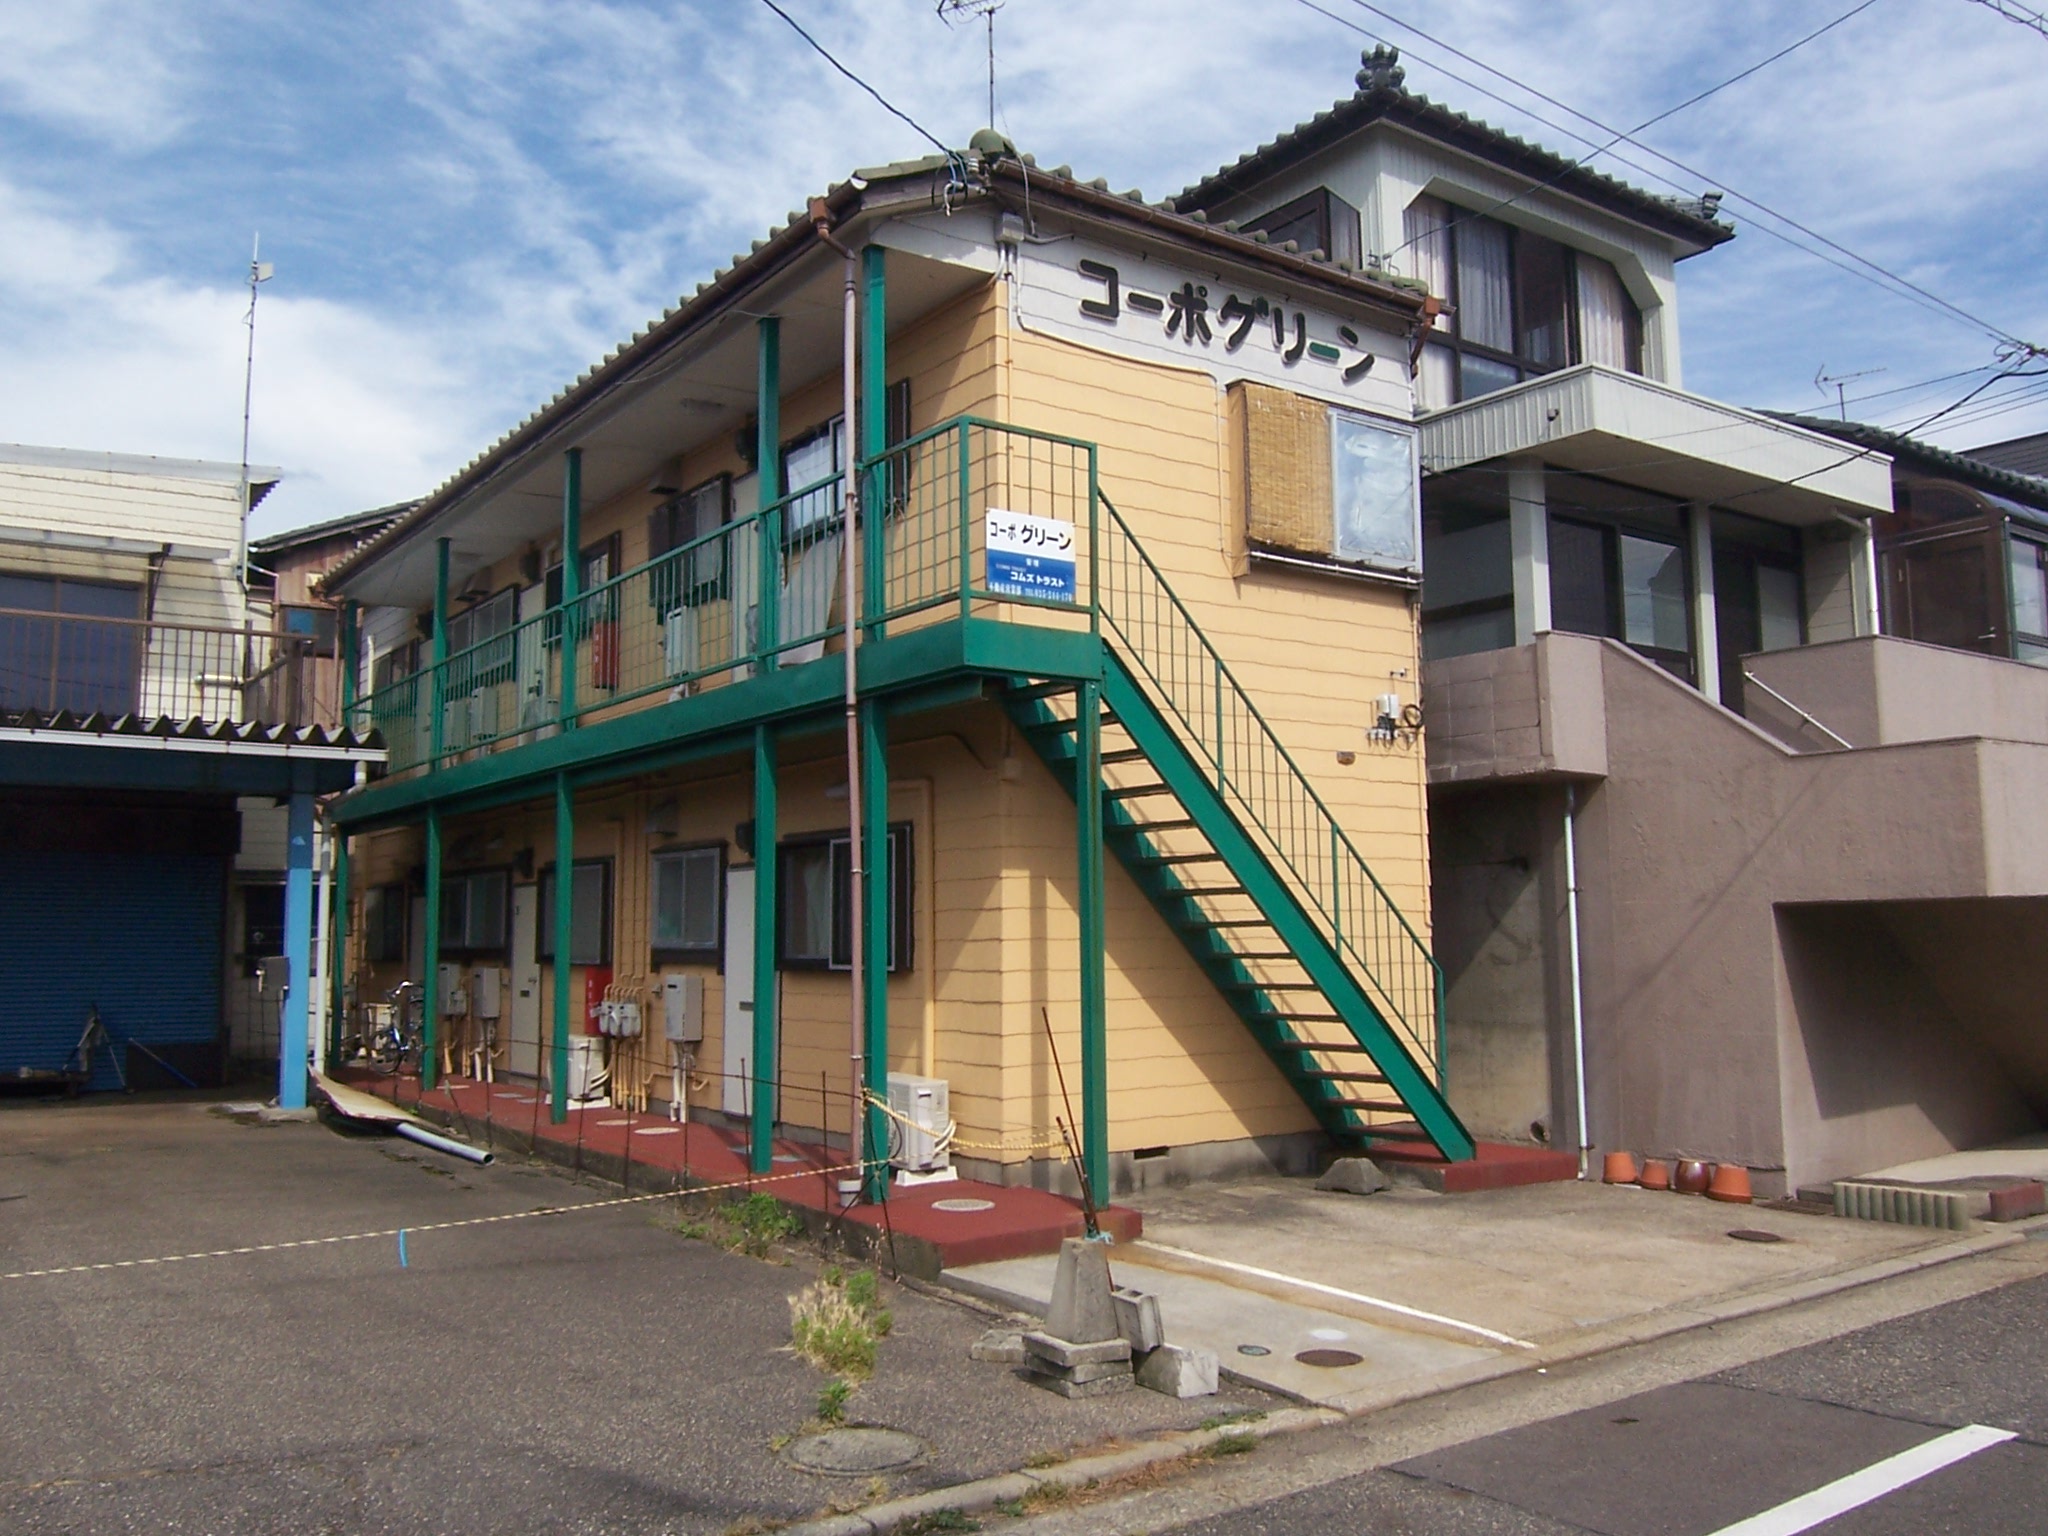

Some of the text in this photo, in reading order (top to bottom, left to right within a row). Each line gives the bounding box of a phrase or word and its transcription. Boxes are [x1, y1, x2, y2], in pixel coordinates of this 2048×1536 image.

[1077, 258, 1376, 383] コーポグリーン
